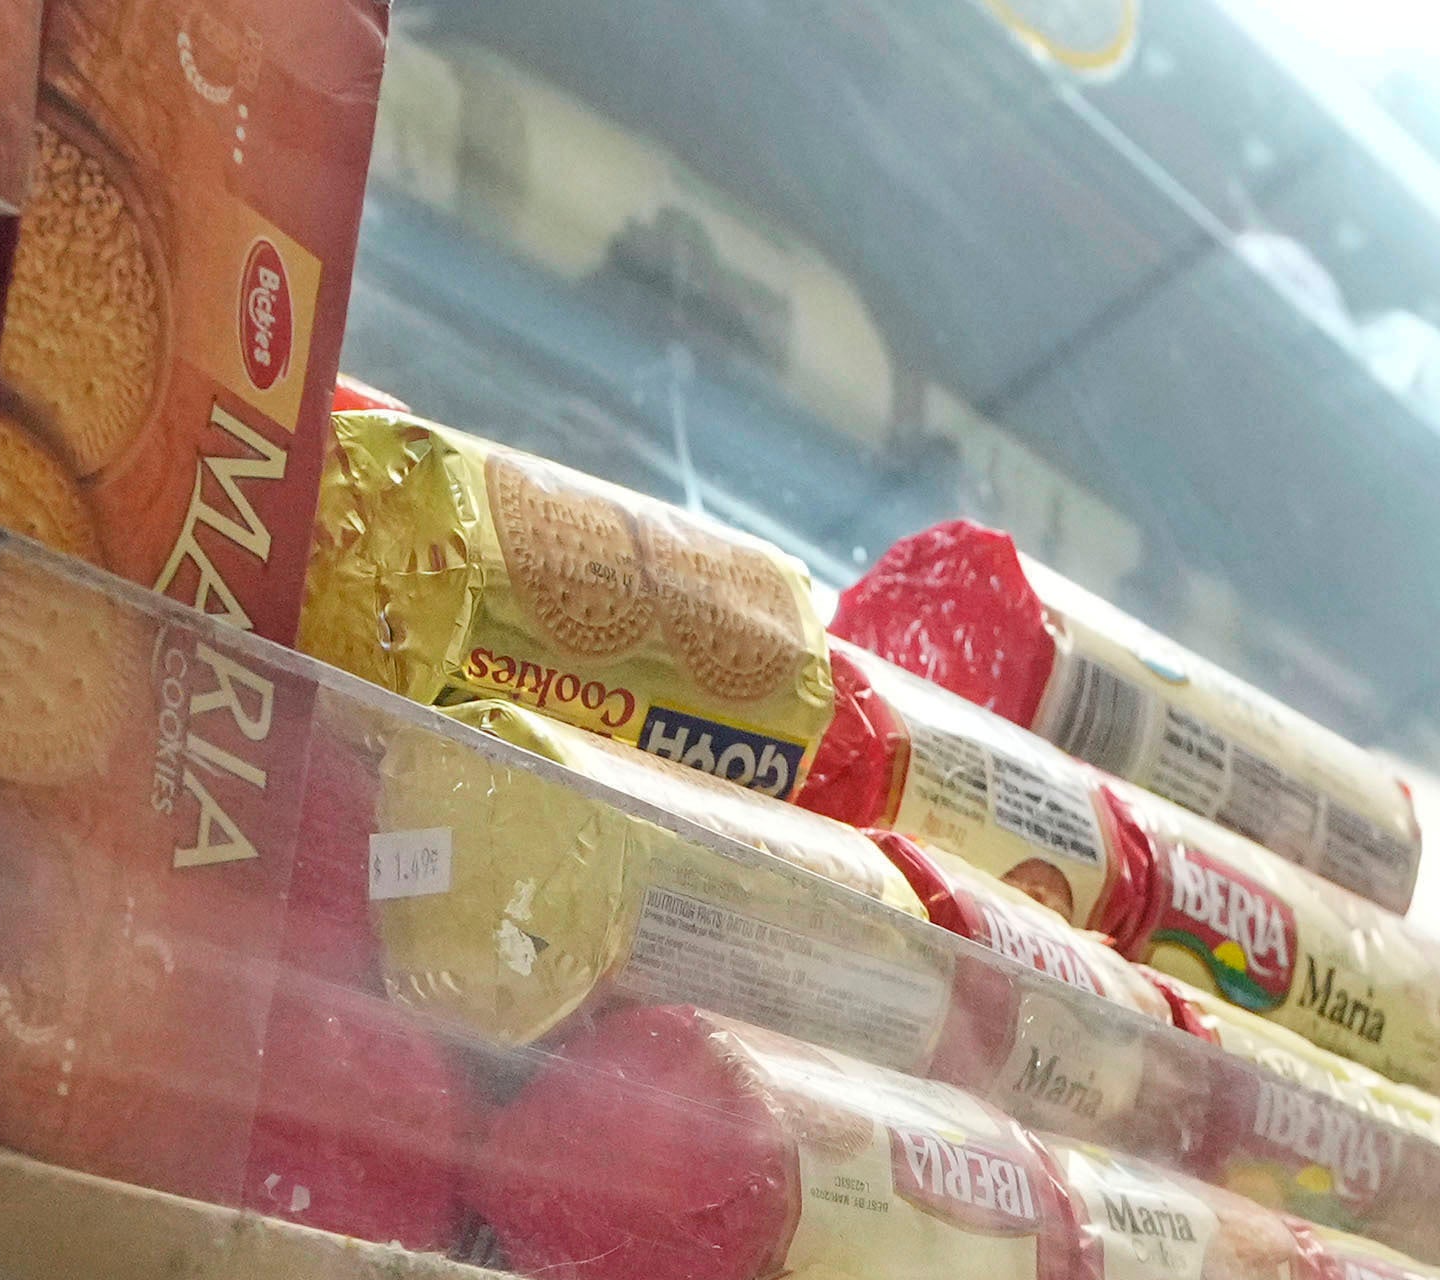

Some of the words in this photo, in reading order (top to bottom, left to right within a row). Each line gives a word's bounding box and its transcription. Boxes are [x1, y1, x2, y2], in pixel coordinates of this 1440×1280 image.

[173, 402, 289, 869] MARIA
[150, 647, 188, 816] COOKIES
[468, 647, 636, 728] Cookies
[984, 906, 1093, 991] IBERIA
[1167, 845, 1291, 972] IBERIA
[1298, 956, 1386, 1046] Maria
[1020, 1048, 1104, 1119] Maria
[903, 1129, 1034, 1221] IBERIA
[1254, 1080, 1383, 1193] IBERIA
[1102, 1190, 1196, 1243] Maria
